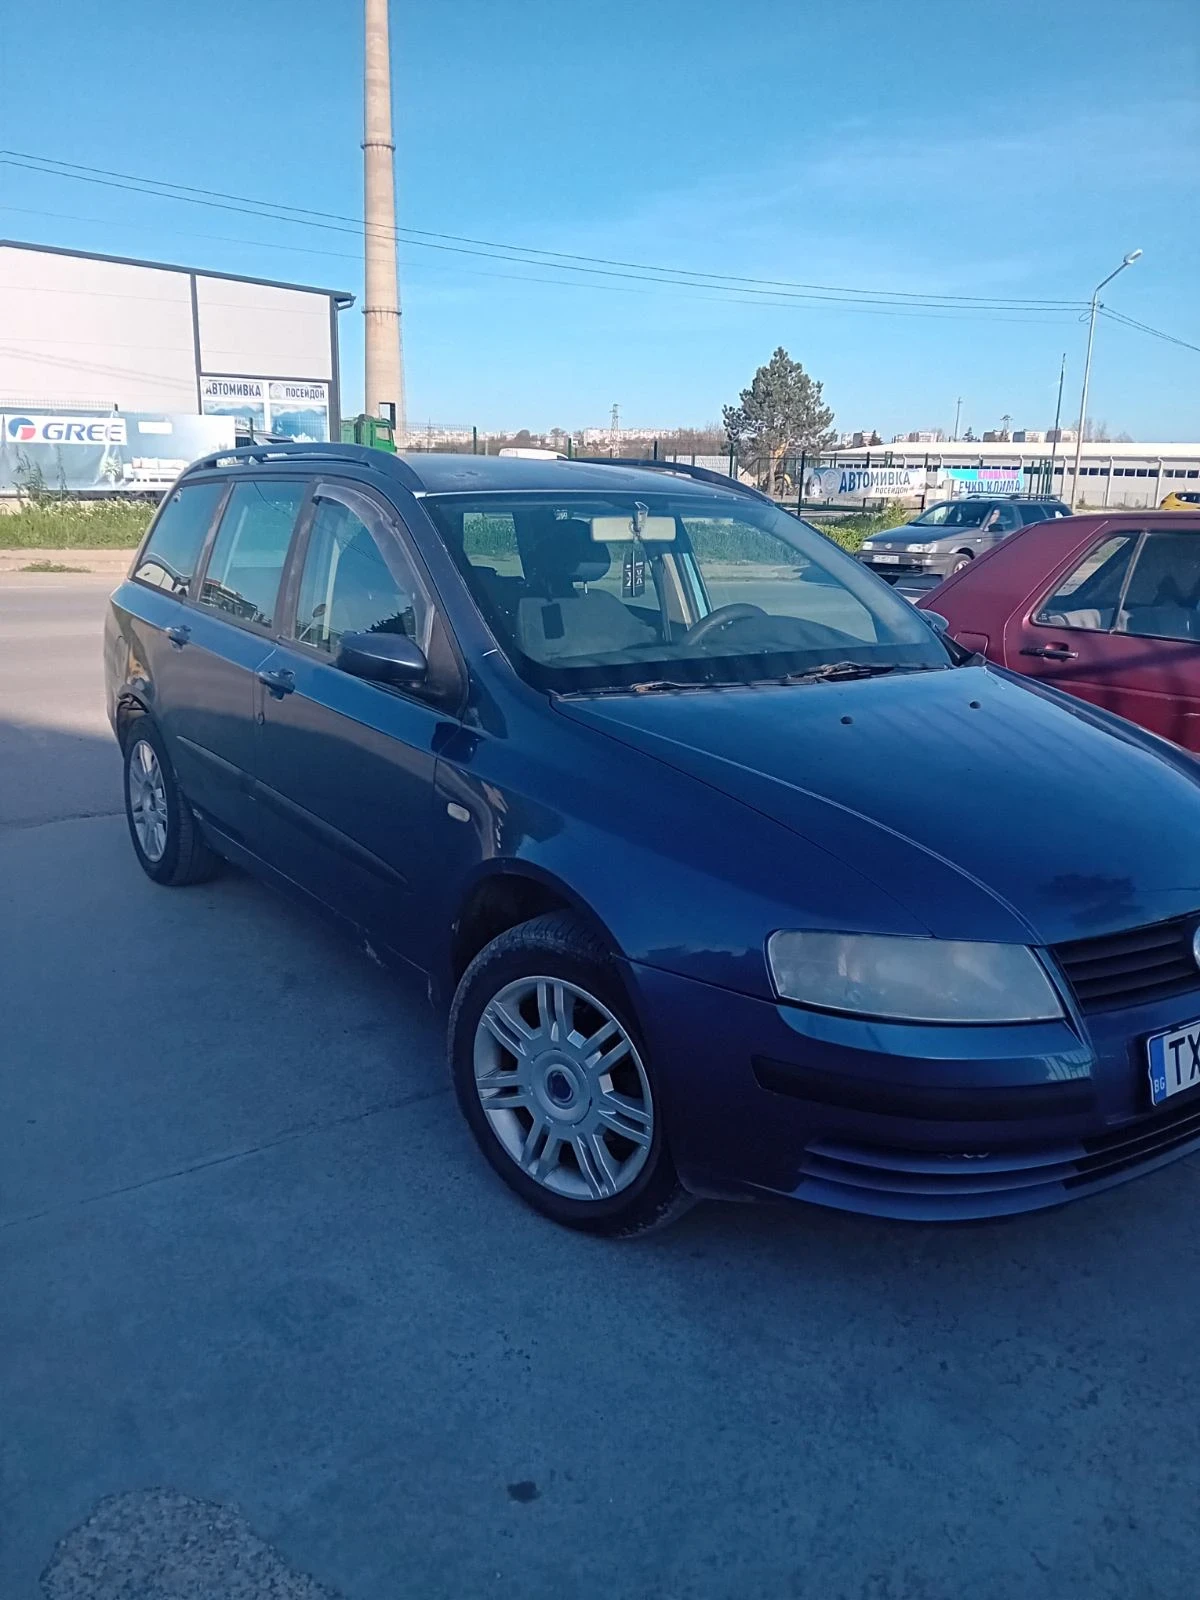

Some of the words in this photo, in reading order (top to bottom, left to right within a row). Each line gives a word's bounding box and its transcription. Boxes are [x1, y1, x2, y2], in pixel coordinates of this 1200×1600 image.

[205, 383, 262, 397] АВТОМИВКА
[41, 422, 124, 442] GREE
[838, 471, 911, 494] АВТОМИВКА
[1154, 1077, 1165, 1093] BG
